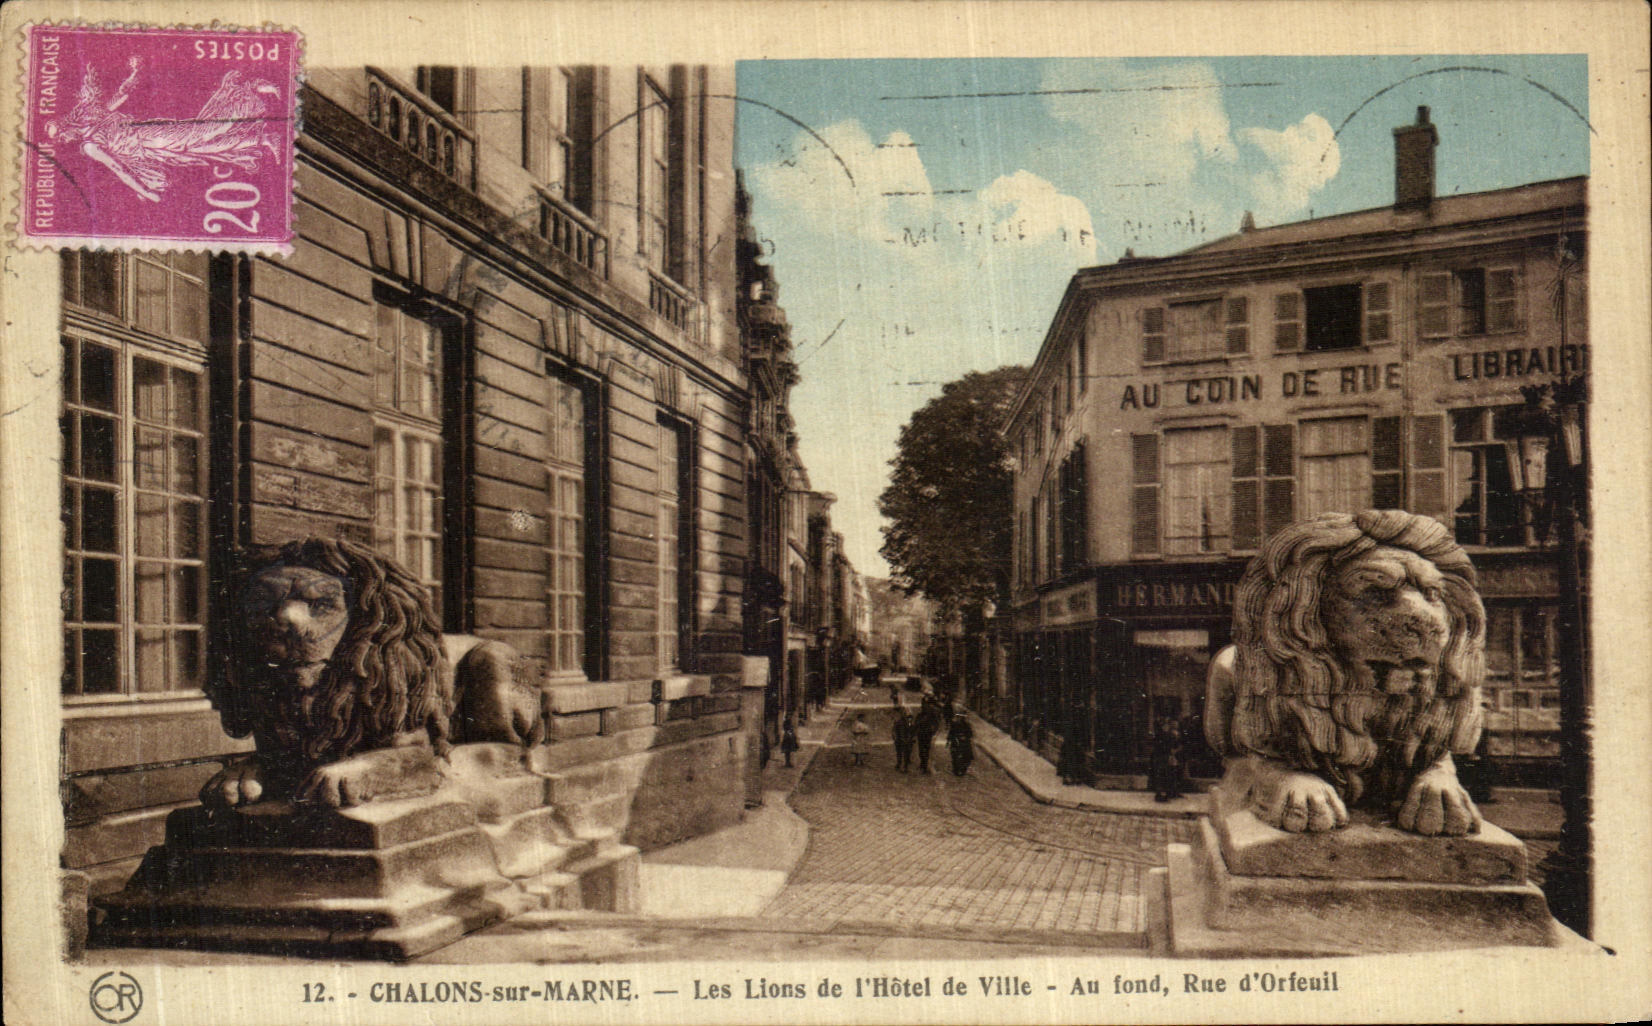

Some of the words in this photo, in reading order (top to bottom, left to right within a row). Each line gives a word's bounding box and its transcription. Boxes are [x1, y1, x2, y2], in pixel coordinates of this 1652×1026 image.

[194, 39, 280, 62] POSTES
[1120, 384, 1160, 410] AU
[1186, 375, 1262, 404] COIN
[1283, 369, 1319, 397] DE
[1340, 362, 1402, 393] RUE
